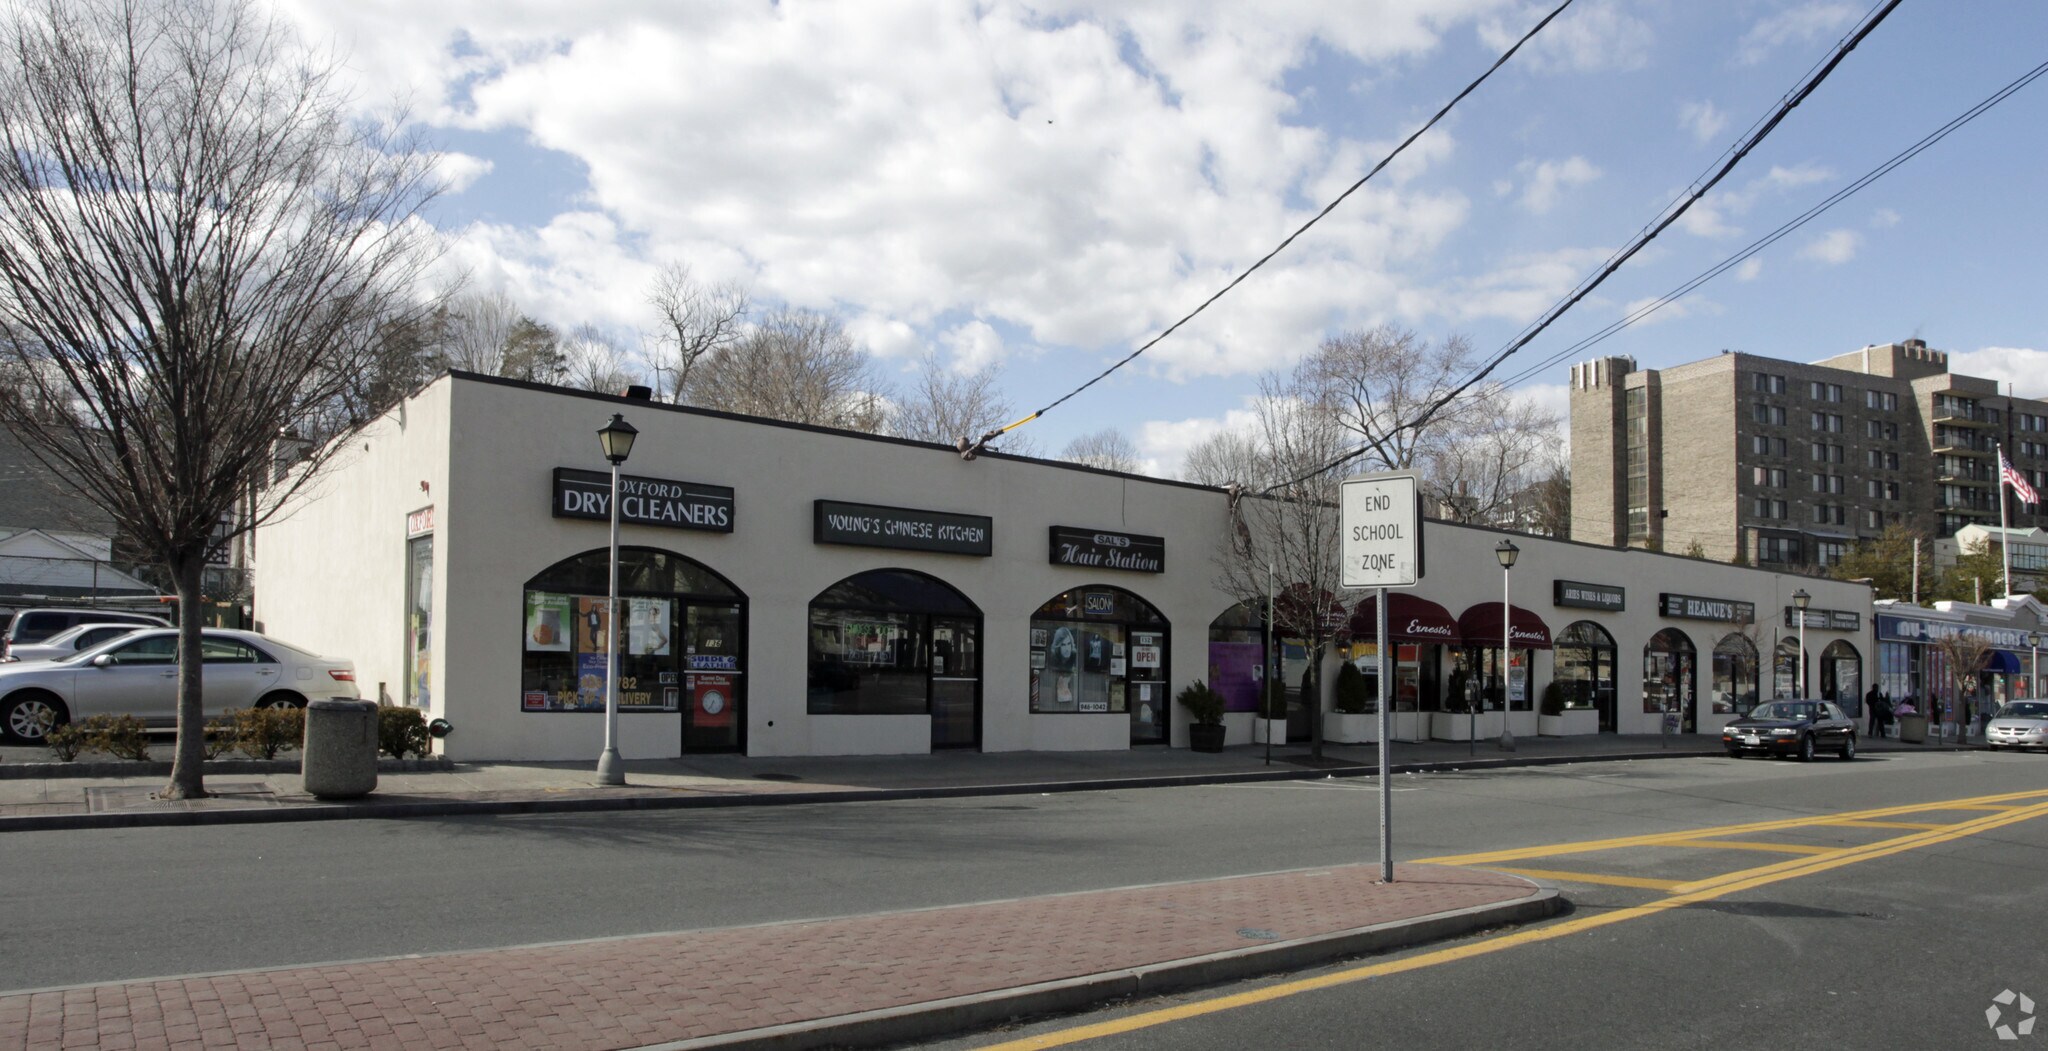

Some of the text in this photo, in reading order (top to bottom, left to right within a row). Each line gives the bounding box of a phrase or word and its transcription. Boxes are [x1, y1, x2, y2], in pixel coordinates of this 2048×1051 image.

[619, 480, 682, 498] OXFORD
[564, 489, 728, 527] DRY CLEANERS
[1366, 495, 1390, 512] END
[828, 514, 984, 543] YOUNG'S CHINESE KITCHEN
[1353, 523, 1403, 542] SCHOOL
[1097, 535, 1127, 547] SAL'S
[1061, 543, 1158, 571] Hair Station
[1362, 554, 1396, 570] ZONE
[1088, 597, 1112, 610] SALON
[1687, 599, 1733, 619] HEANUE'S
[1406, 619, 1451, 635] Ernesto's
[1509, 625, 1545, 641] Ernesto's
[1136, 651, 1156, 662] OPEN
[617, 691, 652, 705] LIVERY
